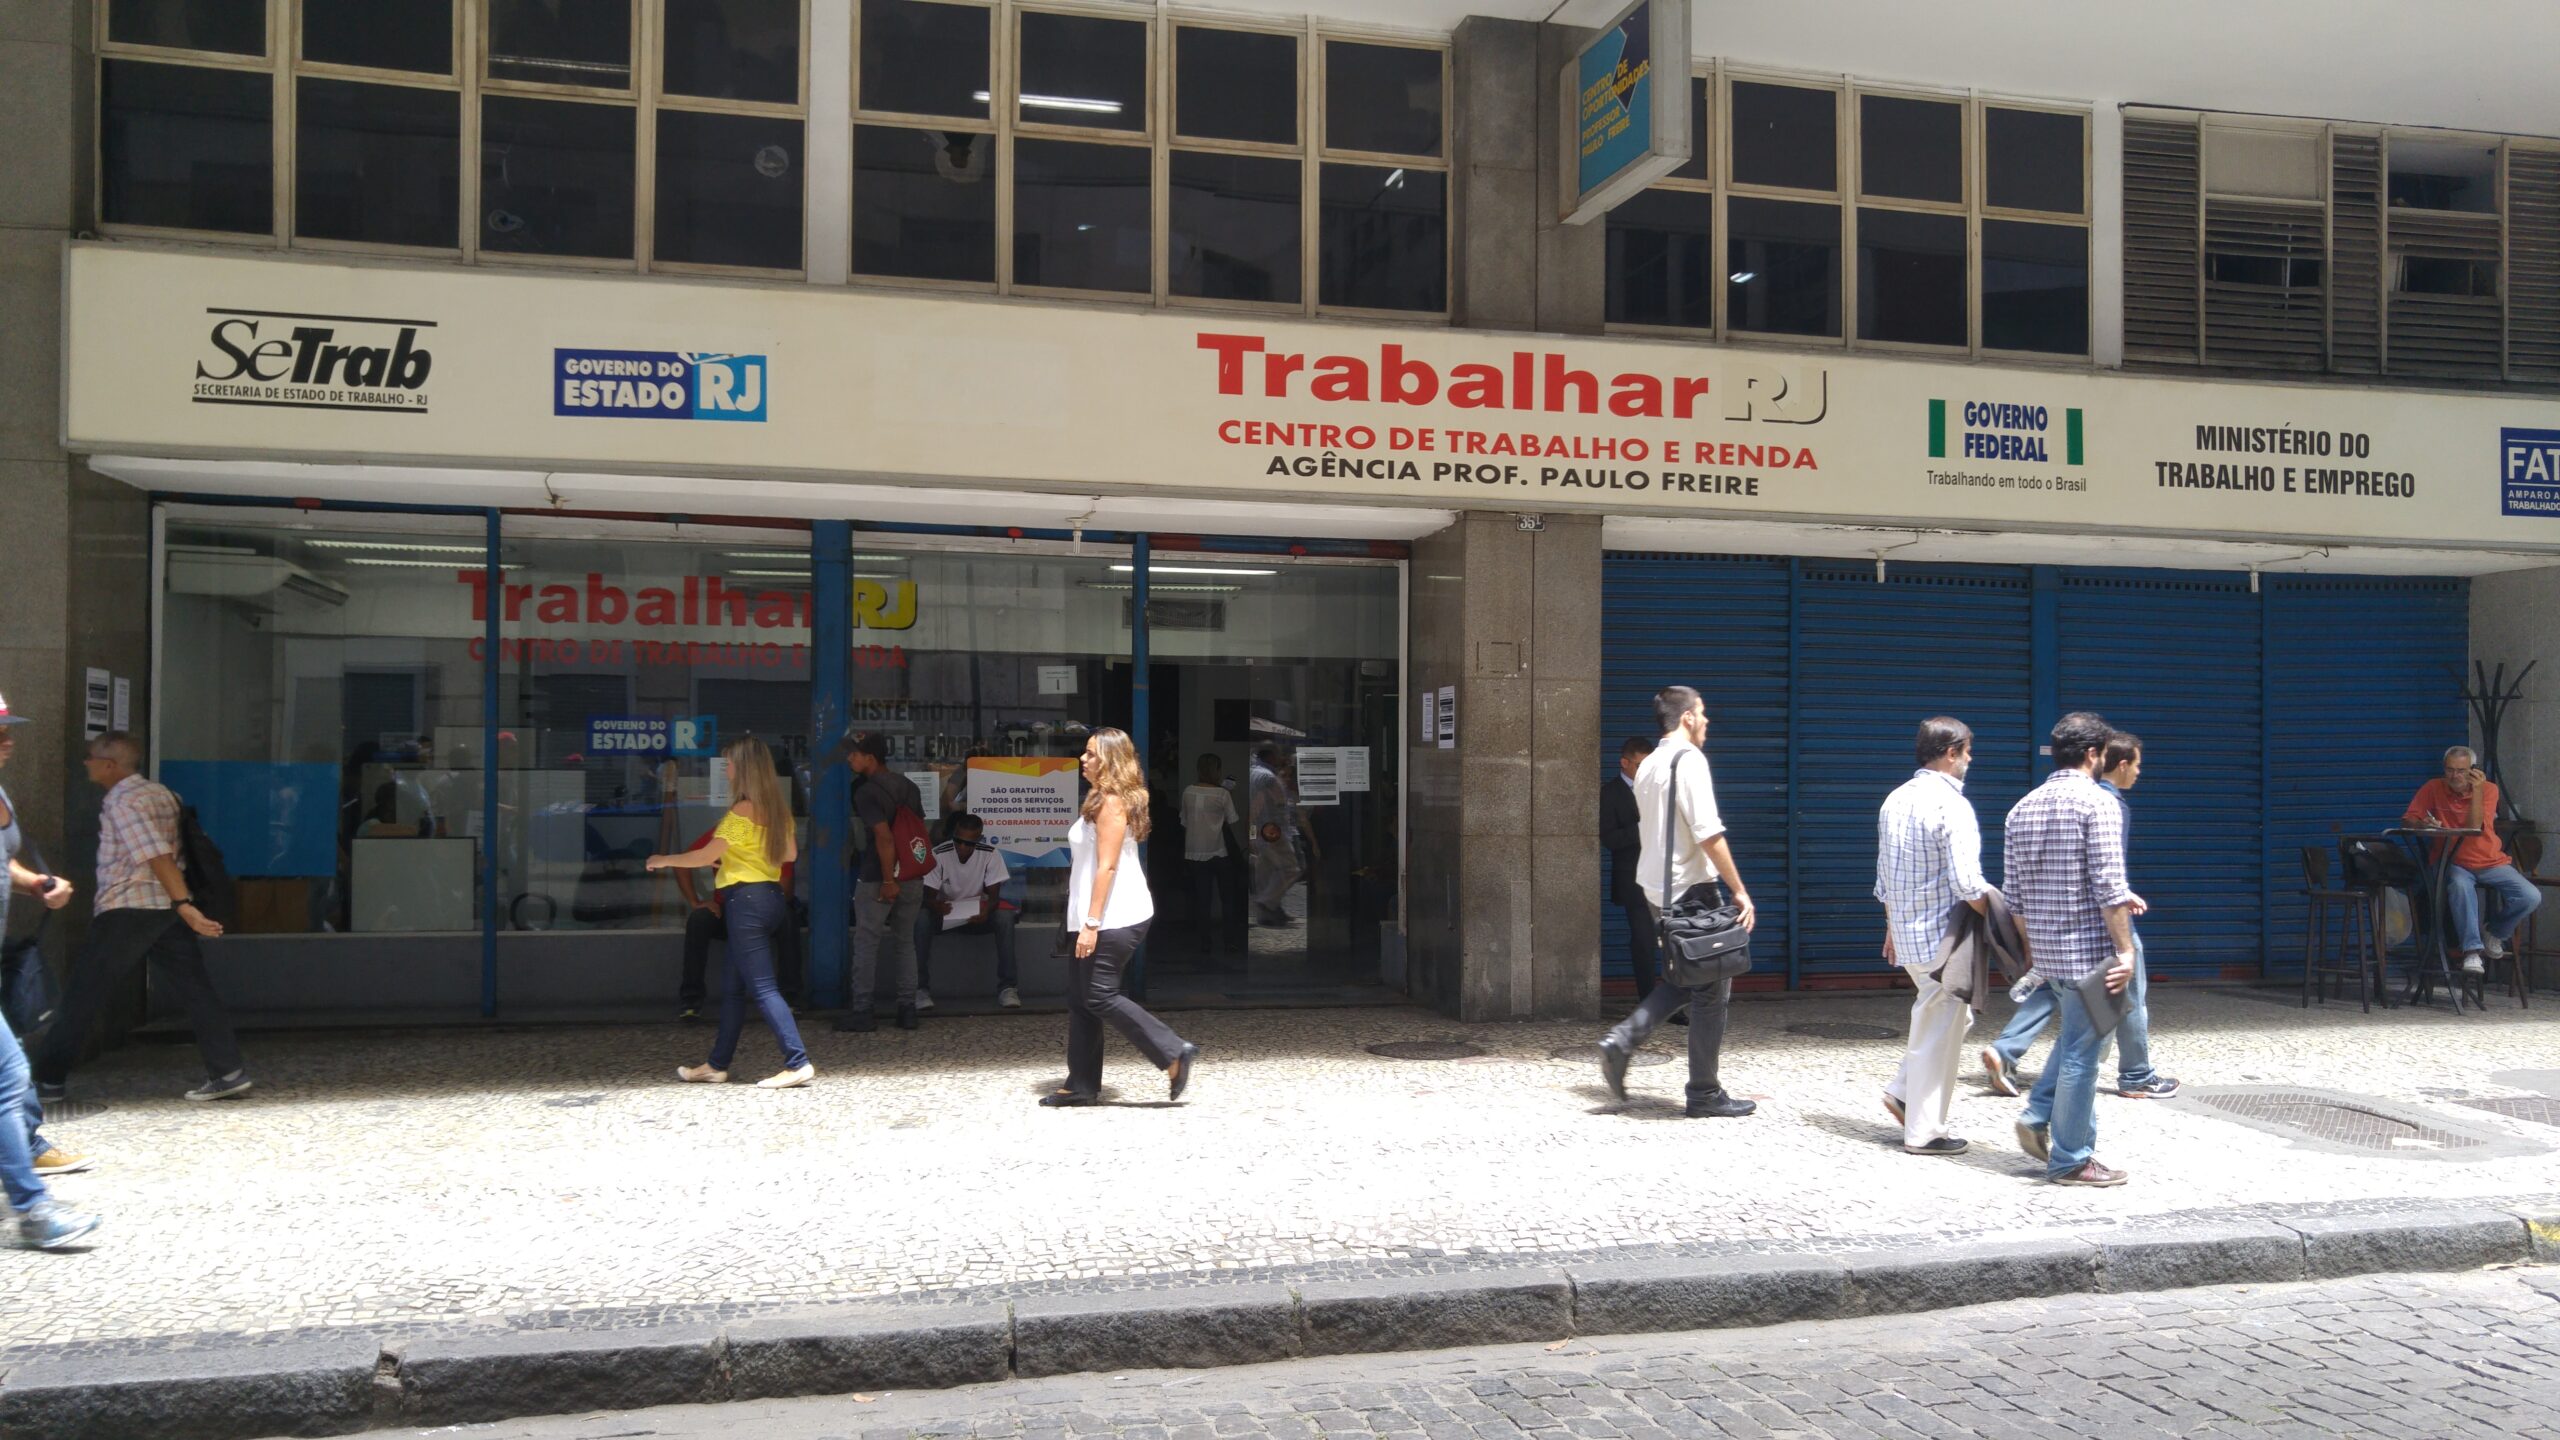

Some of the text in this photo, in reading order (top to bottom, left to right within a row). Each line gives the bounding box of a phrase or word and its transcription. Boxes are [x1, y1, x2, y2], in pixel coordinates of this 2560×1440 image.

[1617, 58, 1629, 78] DE
[196, 319, 432, 390] SeTrab
[565, 358, 685, 378] GOVERNO DO
[563, 379, 685, 410] ESTADO
[700, 363, 761, 412] RJ
[1197, 333, 1827, 425] Trabalhar RJ
[193, 384, 261, 398] SECRETARIA
[265, 387, 279, 399] DE
[284, 388, 326, 401] ESTADO
[330, 390, 344, 402] DE
[347, 391, 404, 404] TRABALHO
[416, 395, 428, 406] RJ
[1964, 401, 2048, 431] GOVERNO
[1218, 420, 1818, 470] CENTRO DE TRABALHO E RENDA
[1964, 432, 2048, 462] FEDERAL
[2196, 422, 2370, 459] MINISTÉRIO DO
[1266, 451, 1759, 496] AGÊNCIA PROF. PAULO FREIRE
[2155, 461, 2415, 498] TRABALHO E EMPREGO
[2508, 447, 2560, 481] FAT
[1927, 470, 2087, 492] Trabalhando em todo o Brasil
[2508, 490, 2551, 500] AMPARO
[853, 579, 918, 630] RJ
[468, 637, 580, 665] CNTRO
[592, 638, 624, 664] DE
[632, 640, 782, 668] TRABALHO
[593, 720, 666, 730] GOVERNO DO
[593, 733, 667, 750] ESTADO
[1024, 797, 1064, 805] SERVIÇOS
